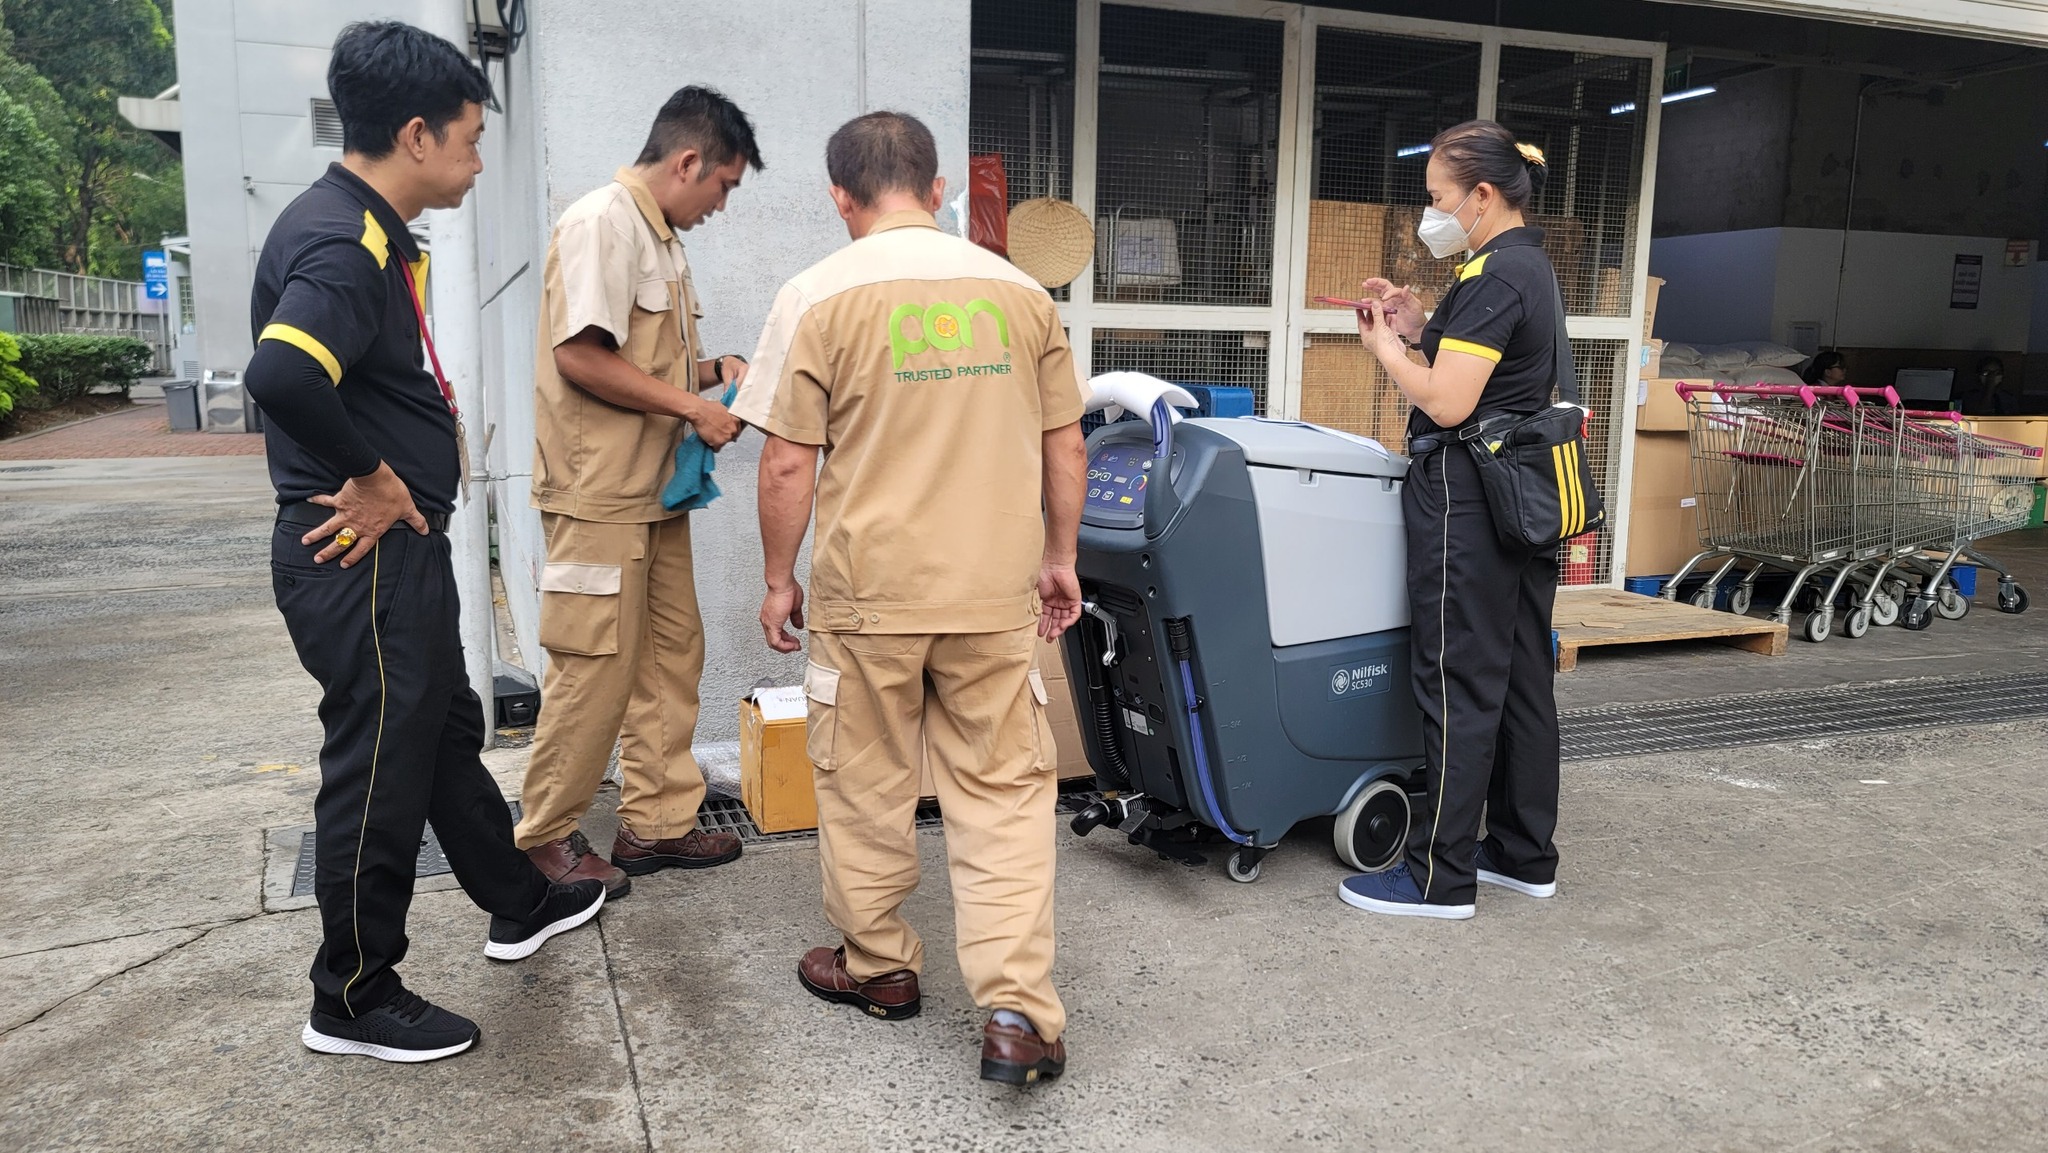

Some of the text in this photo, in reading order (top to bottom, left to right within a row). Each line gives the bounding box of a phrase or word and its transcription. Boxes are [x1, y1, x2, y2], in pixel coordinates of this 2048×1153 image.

[888, 298, 1009, 369] pan
[894, 364, 1012, 383] TRUSTED PARTNER
[1352, 664, 1388, 680] Nilfisk
[1351, 678, 1373, 691] SC530
